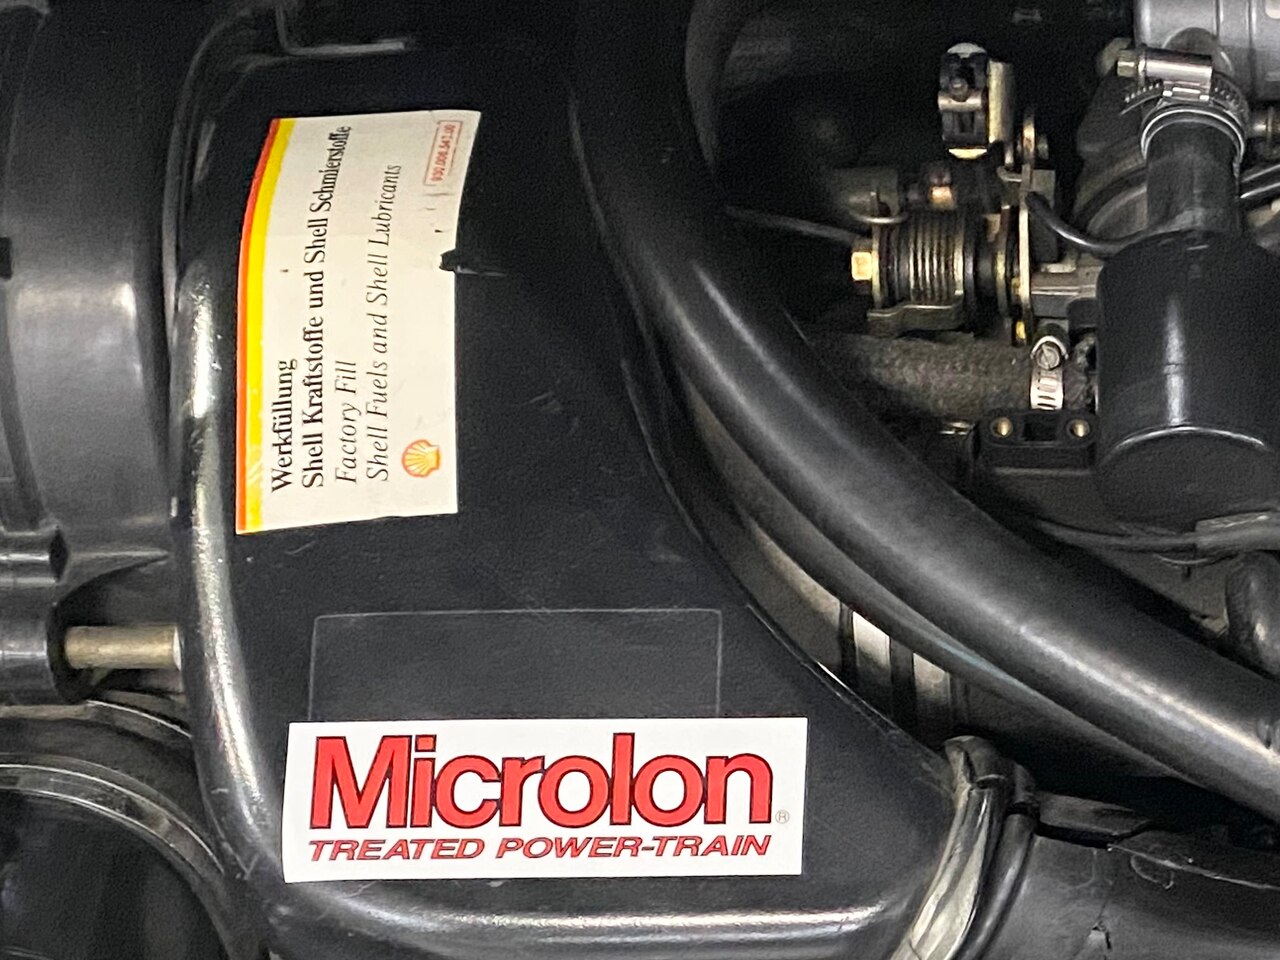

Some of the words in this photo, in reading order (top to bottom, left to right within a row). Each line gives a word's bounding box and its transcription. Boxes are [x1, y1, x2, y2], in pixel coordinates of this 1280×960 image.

[309, 126, 352, 212] Schmierstoffe
[367, 164, 402, 246] Lubricants
[303, 217, 329, 264] Shell
[303, 271, 324, 309] und
[365, 253, 388, 306] Shell
[366, 312, 388, 354] and
[302, 316, 324, 426] Kraftstoffe
[335, 360, 357, 398] Fill
[365, 360, 388, 419] Fuels
[270, 358, 298, 493] Werkfüllung
[335, 402, 361, 485] Factory
[366, 425, 389, 482] Shell
[302, 432, 324, 488] Shell
[308, 731, 775, 831] Microlon
[308, 837, 486, 863] TREATED
[495, 833, 773, 861] POWER-TRAIN
